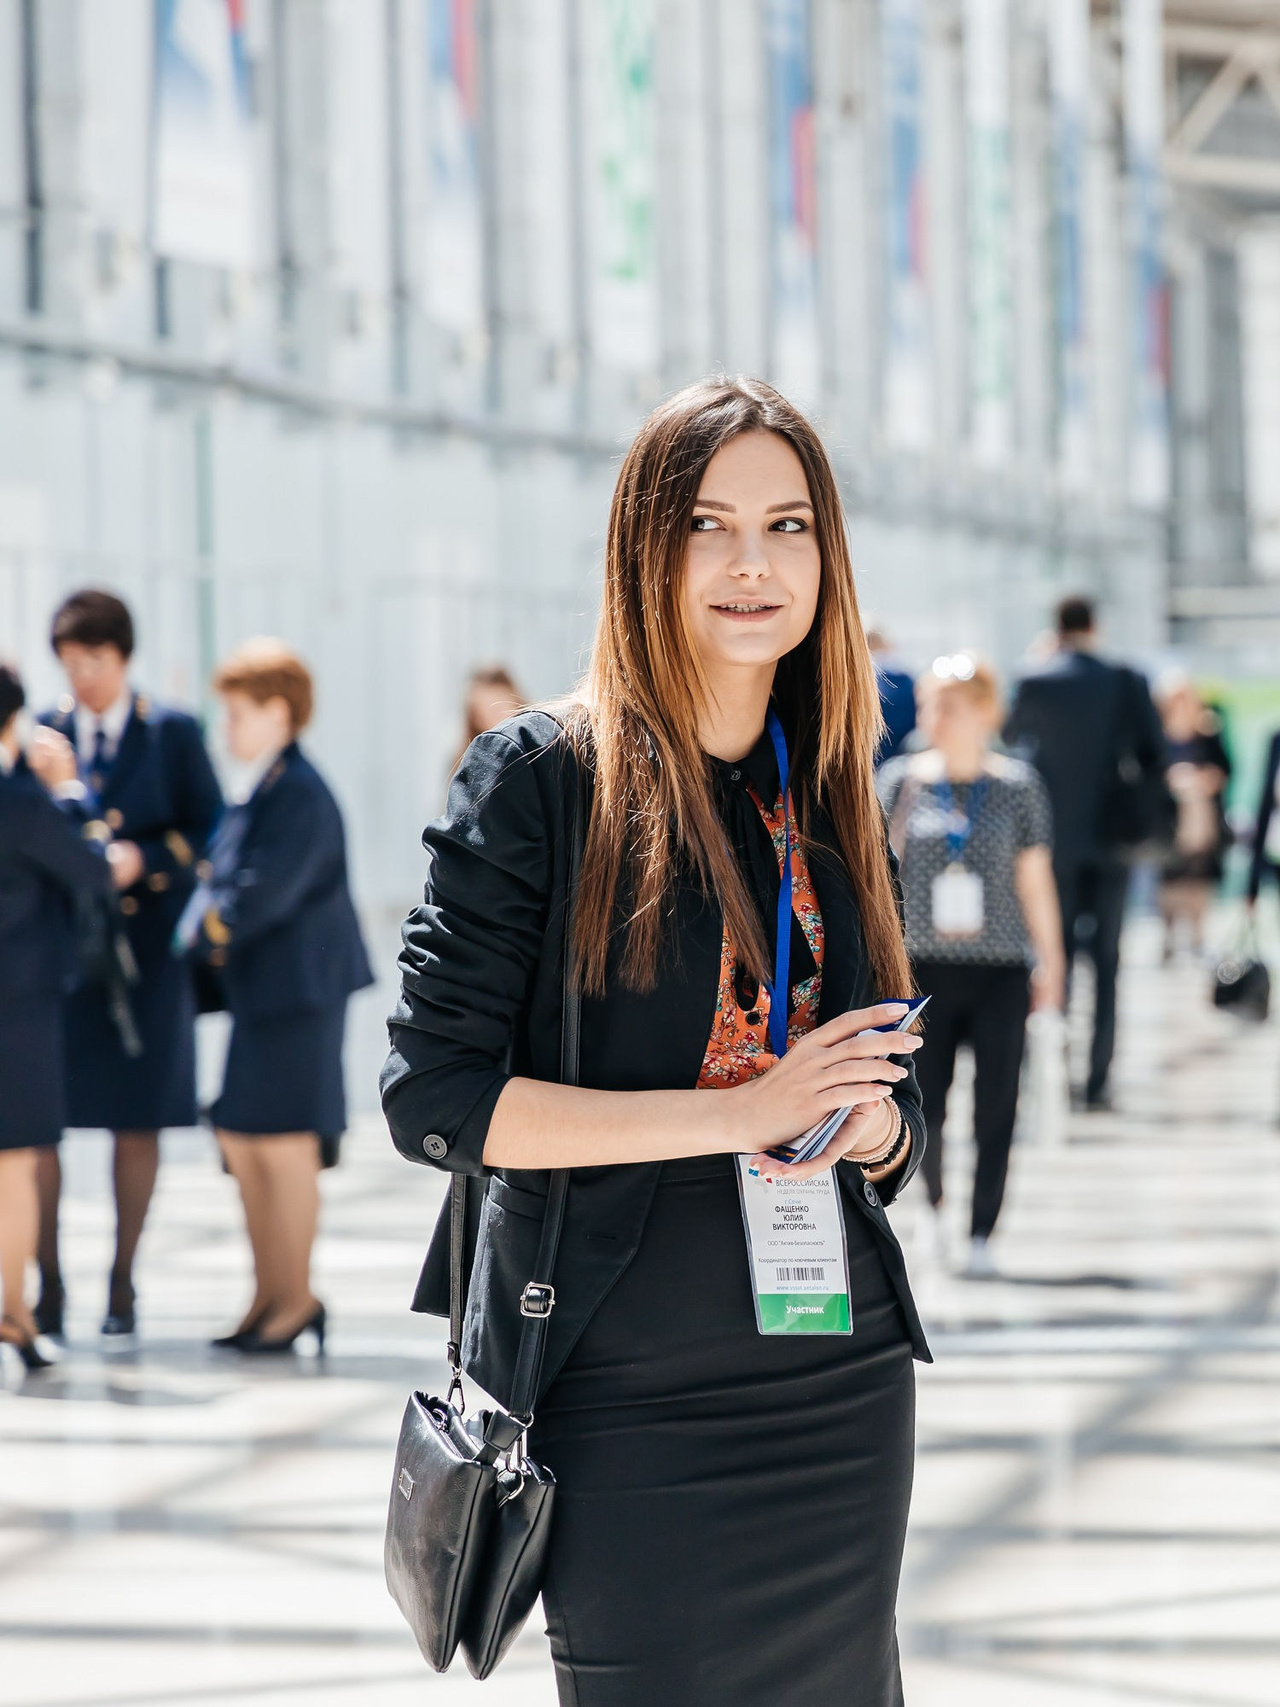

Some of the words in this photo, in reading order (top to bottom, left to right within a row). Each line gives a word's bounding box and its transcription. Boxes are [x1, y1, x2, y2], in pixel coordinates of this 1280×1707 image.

[775, 1178, 830, 1187] ВСЕРОССИЙСКАЯ
[775, 1205, 810, 1213] ФАЩЕНКО
[783, 1214, 804, 1222] ЮЛИЯ
[773, 1223, 817, 1231] ВИКТОРОВНА
[786, 1305, 824, 1314] Участник
